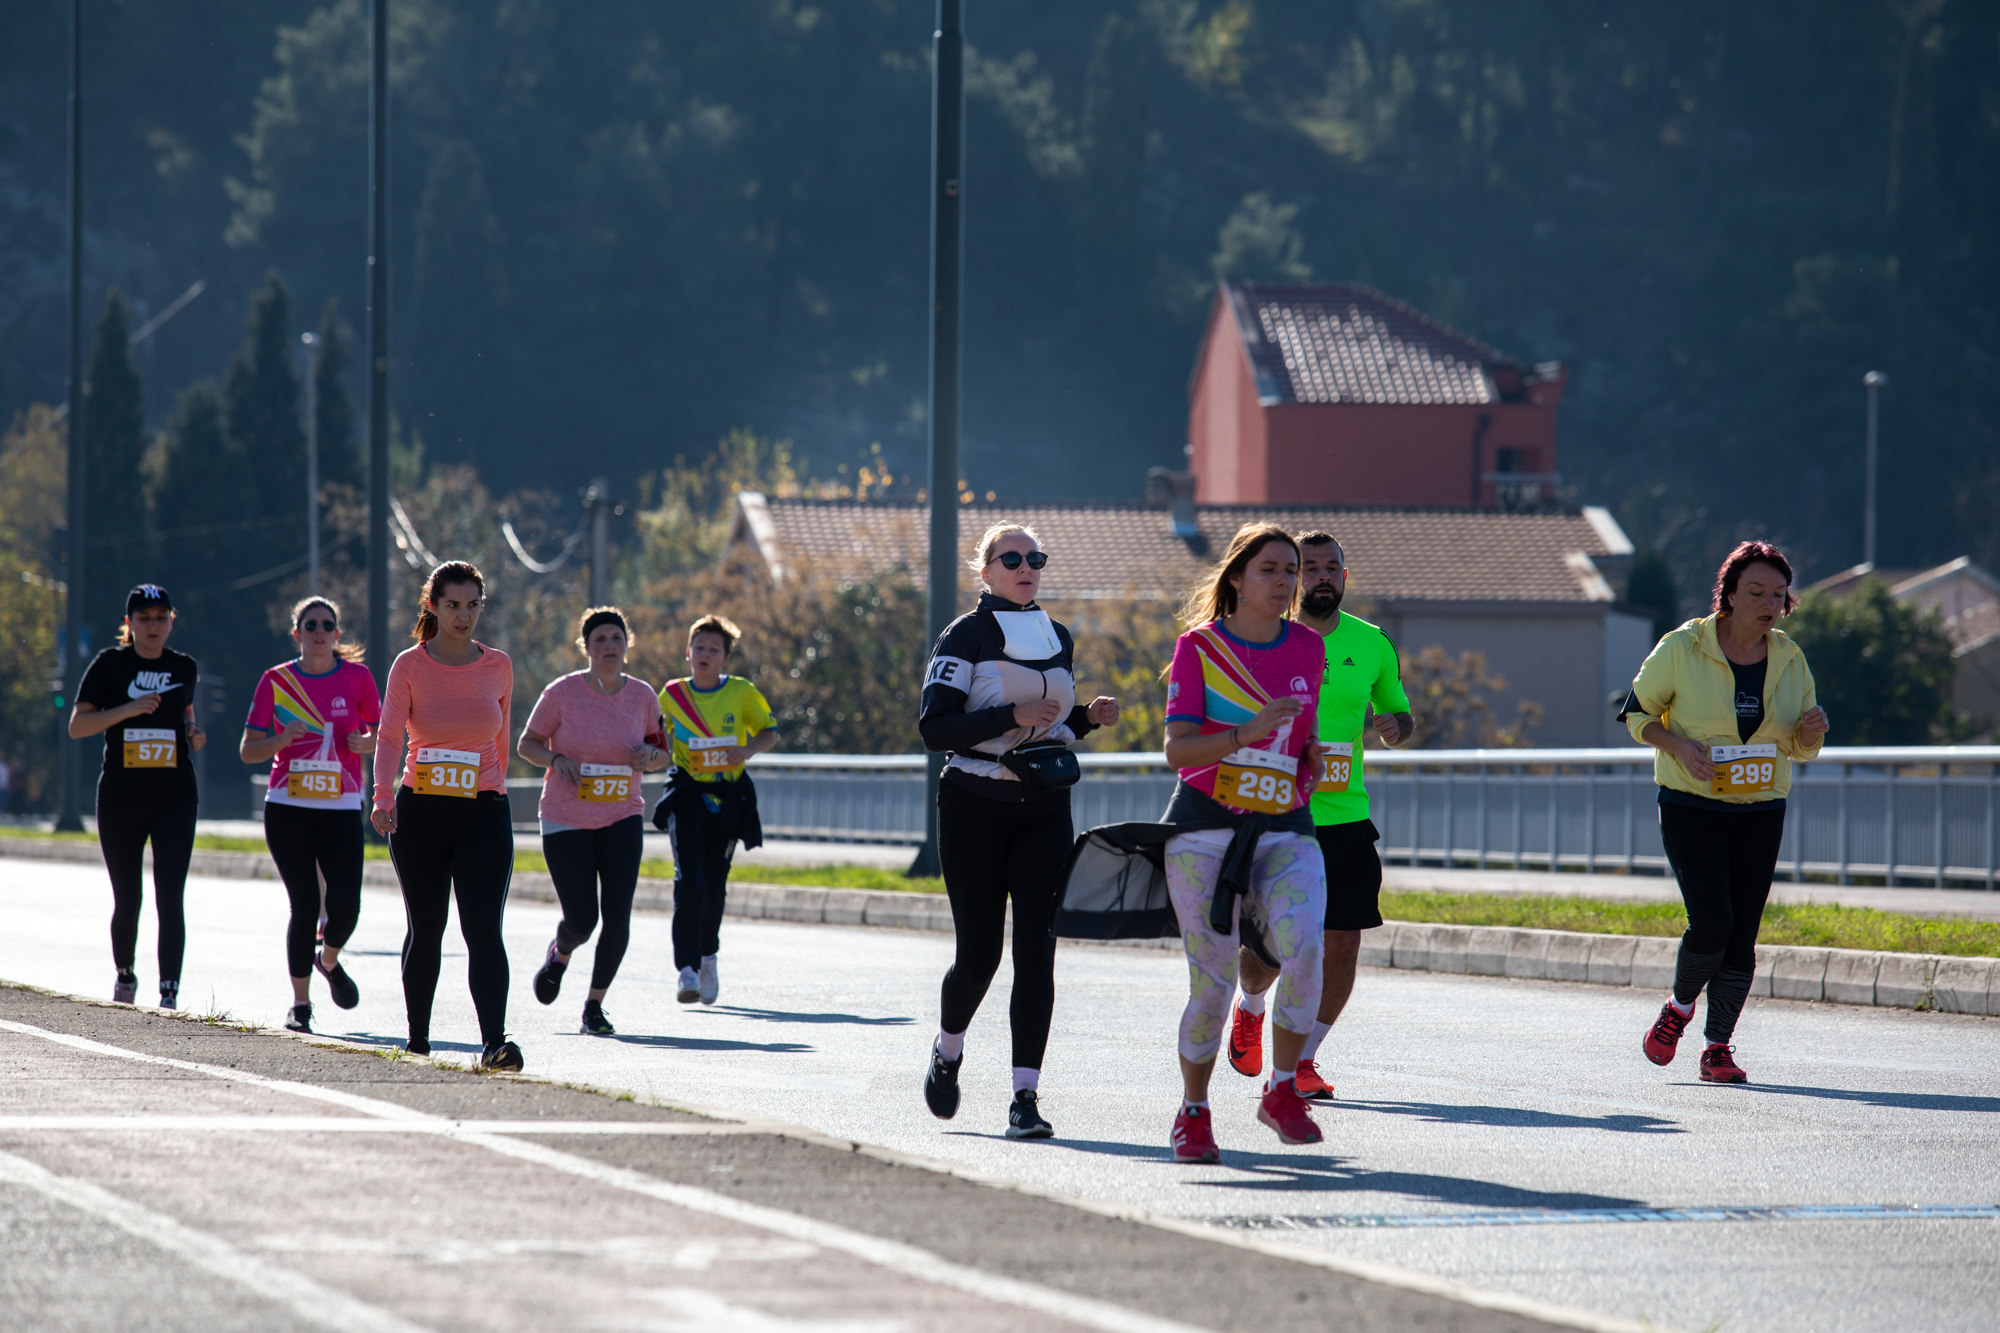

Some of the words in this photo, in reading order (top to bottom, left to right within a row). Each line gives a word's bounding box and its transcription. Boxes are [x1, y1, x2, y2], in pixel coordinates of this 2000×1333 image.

[136, 671, 172, 690] NIKE
[138, 743, 175, 761] 577
[702, 750, 729, 767] 122
[430, 766, 476, 789] 310
[1730, 762, 1774, 785] 299
[301, 774, 339, 792] 451
[592, 779, 629, 796] 375
[1237, 771, 1293, 805] 293
